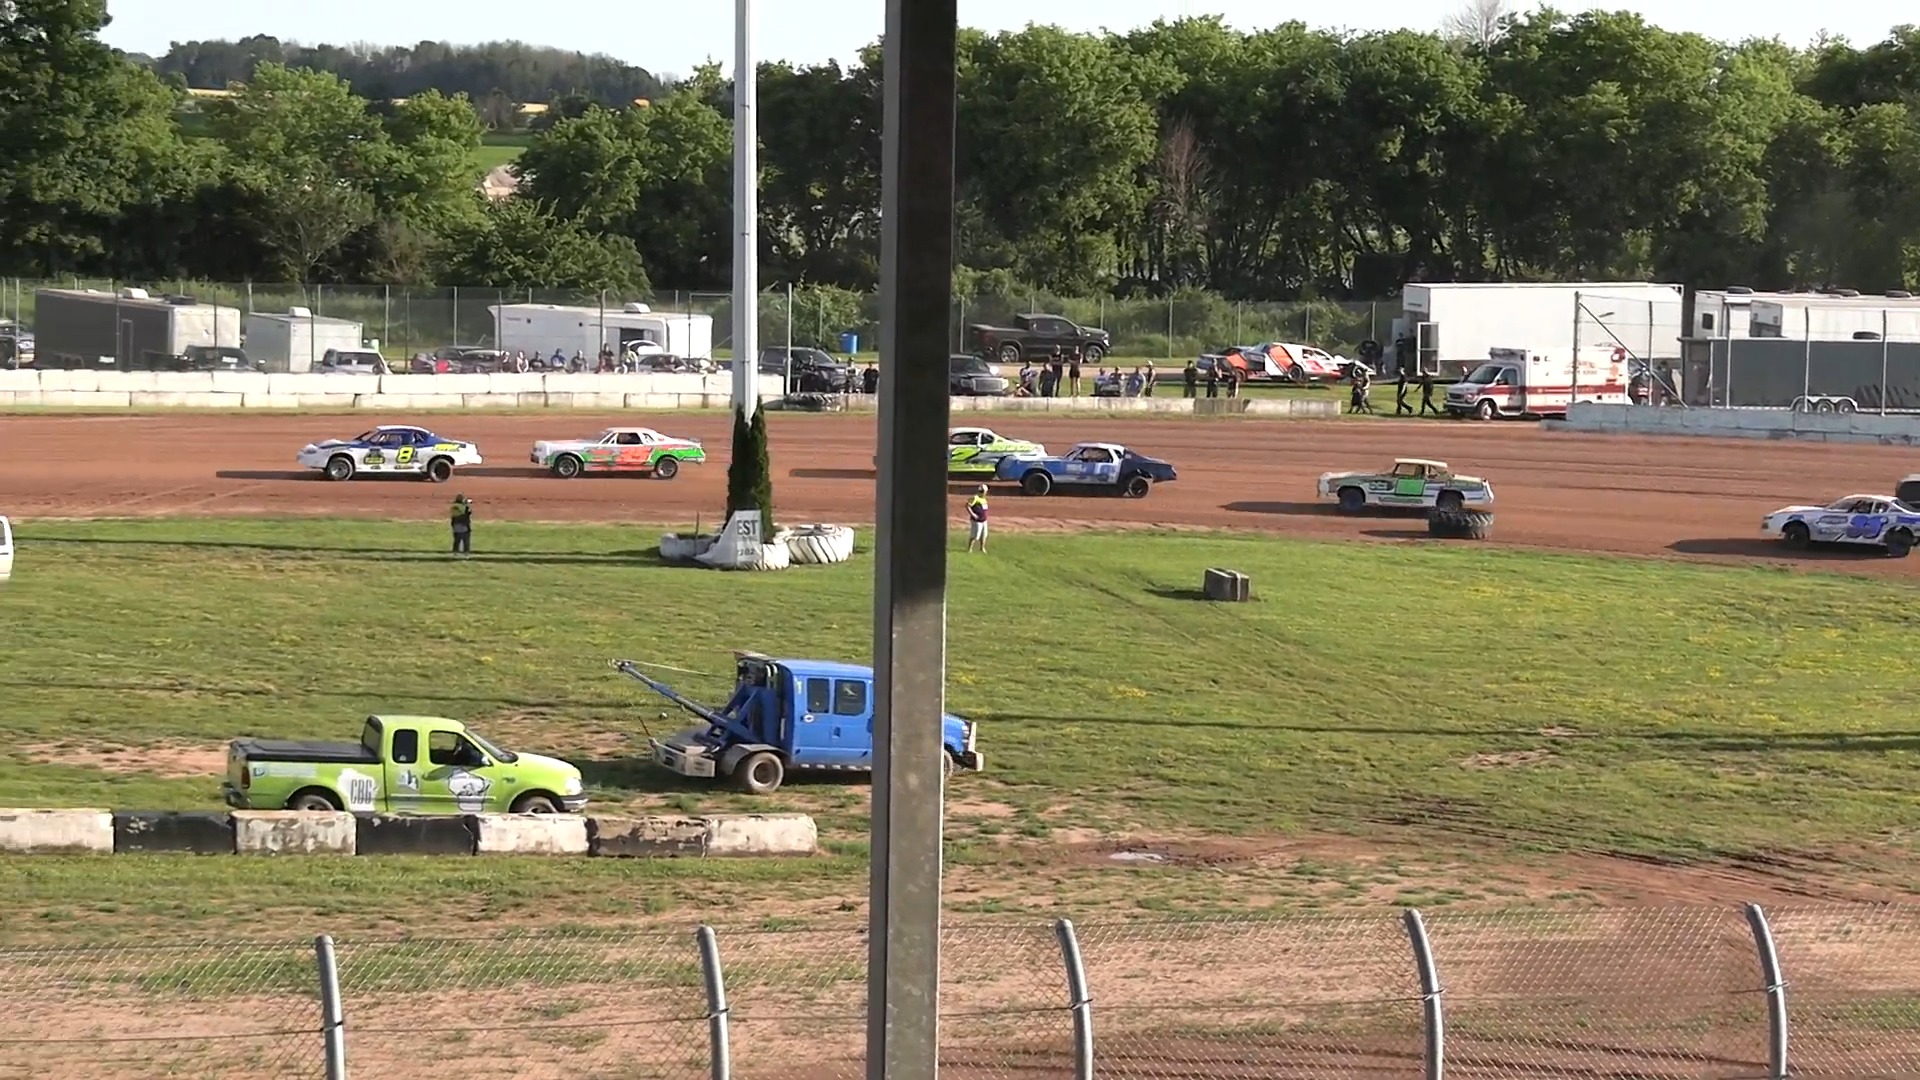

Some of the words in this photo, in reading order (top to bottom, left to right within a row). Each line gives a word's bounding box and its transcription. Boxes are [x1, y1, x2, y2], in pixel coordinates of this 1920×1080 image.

[395, 444, 416, 464] 8
[736, 519, 759, 535] EST
[350, 778, 373, 805] CBG
